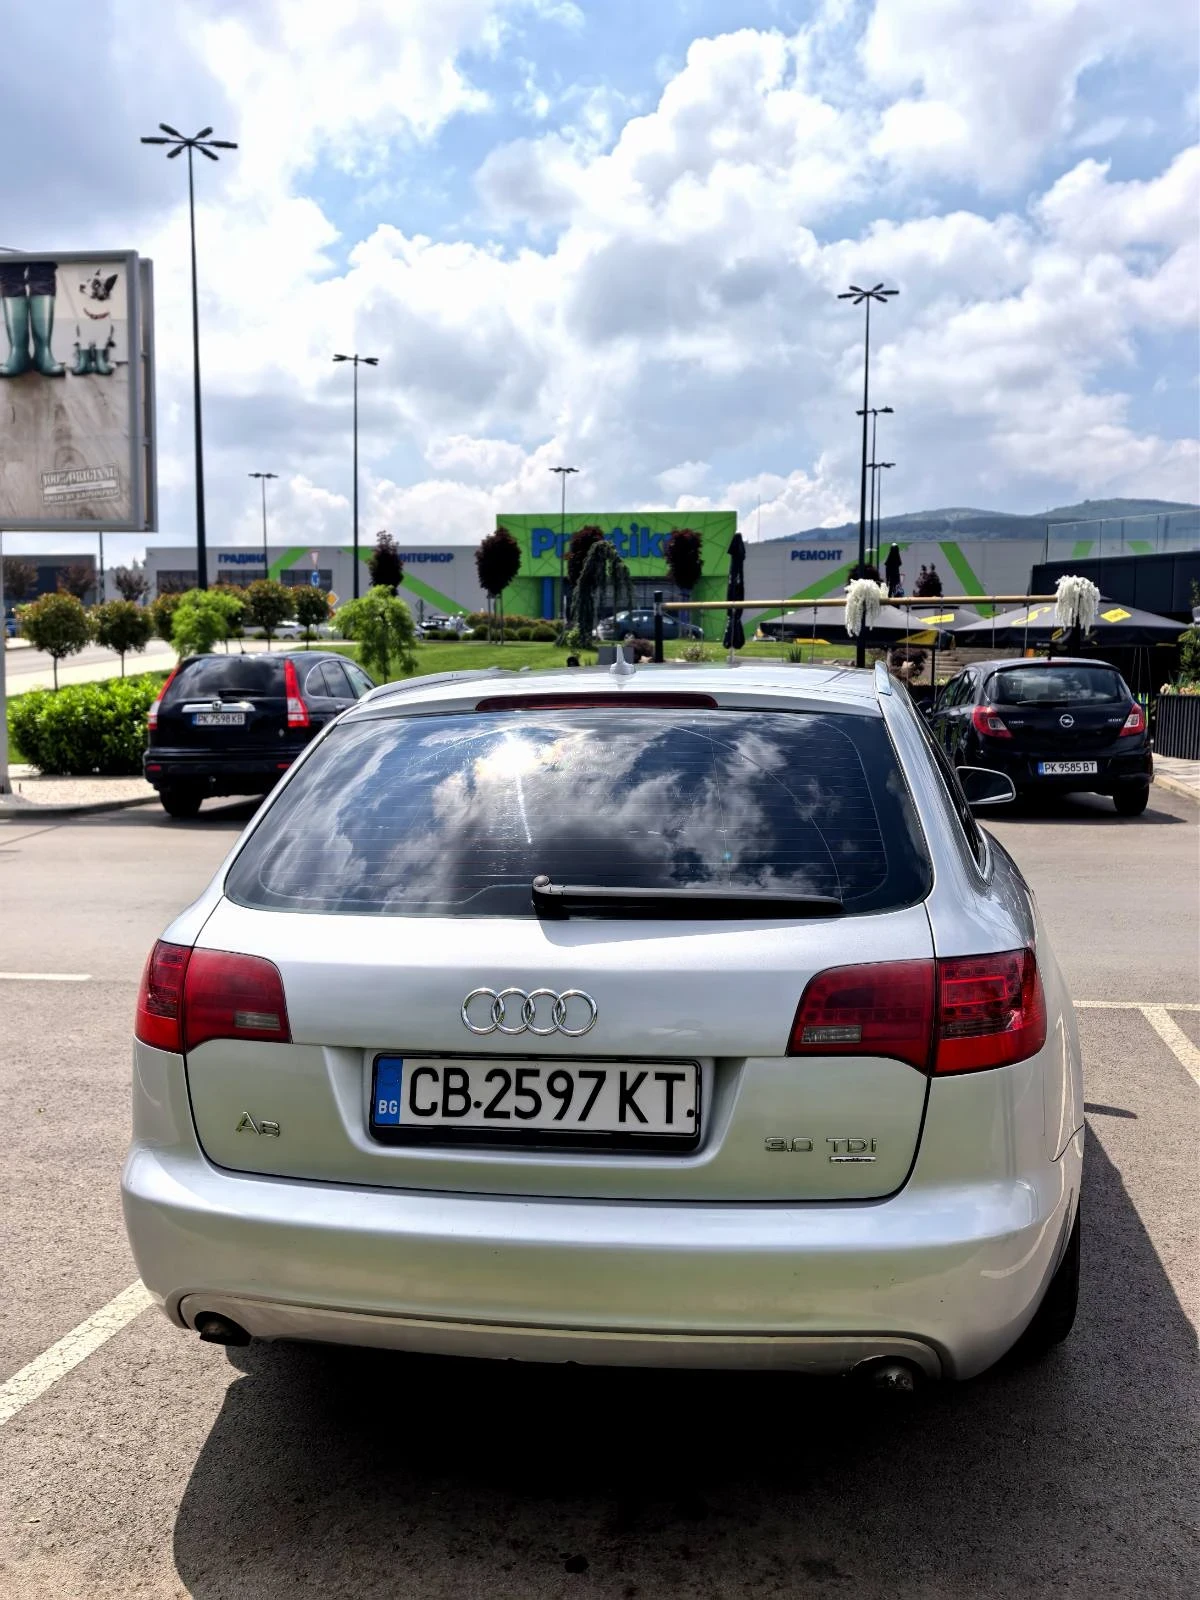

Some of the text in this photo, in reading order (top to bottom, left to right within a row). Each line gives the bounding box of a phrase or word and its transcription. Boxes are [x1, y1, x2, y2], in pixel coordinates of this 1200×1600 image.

[791, 550, 843, 561] РЕМОНТ
[1044, 763, 1057, 773] PK
[1058, 762, 1082, 773] 9585
[1083, 762, 1096, 772] BT
[409, 1067, 686, 1124] CB 2597 KT
[377, 1100, 398, 1115] BG
[765, 1137, 814, 1152] 3.0
